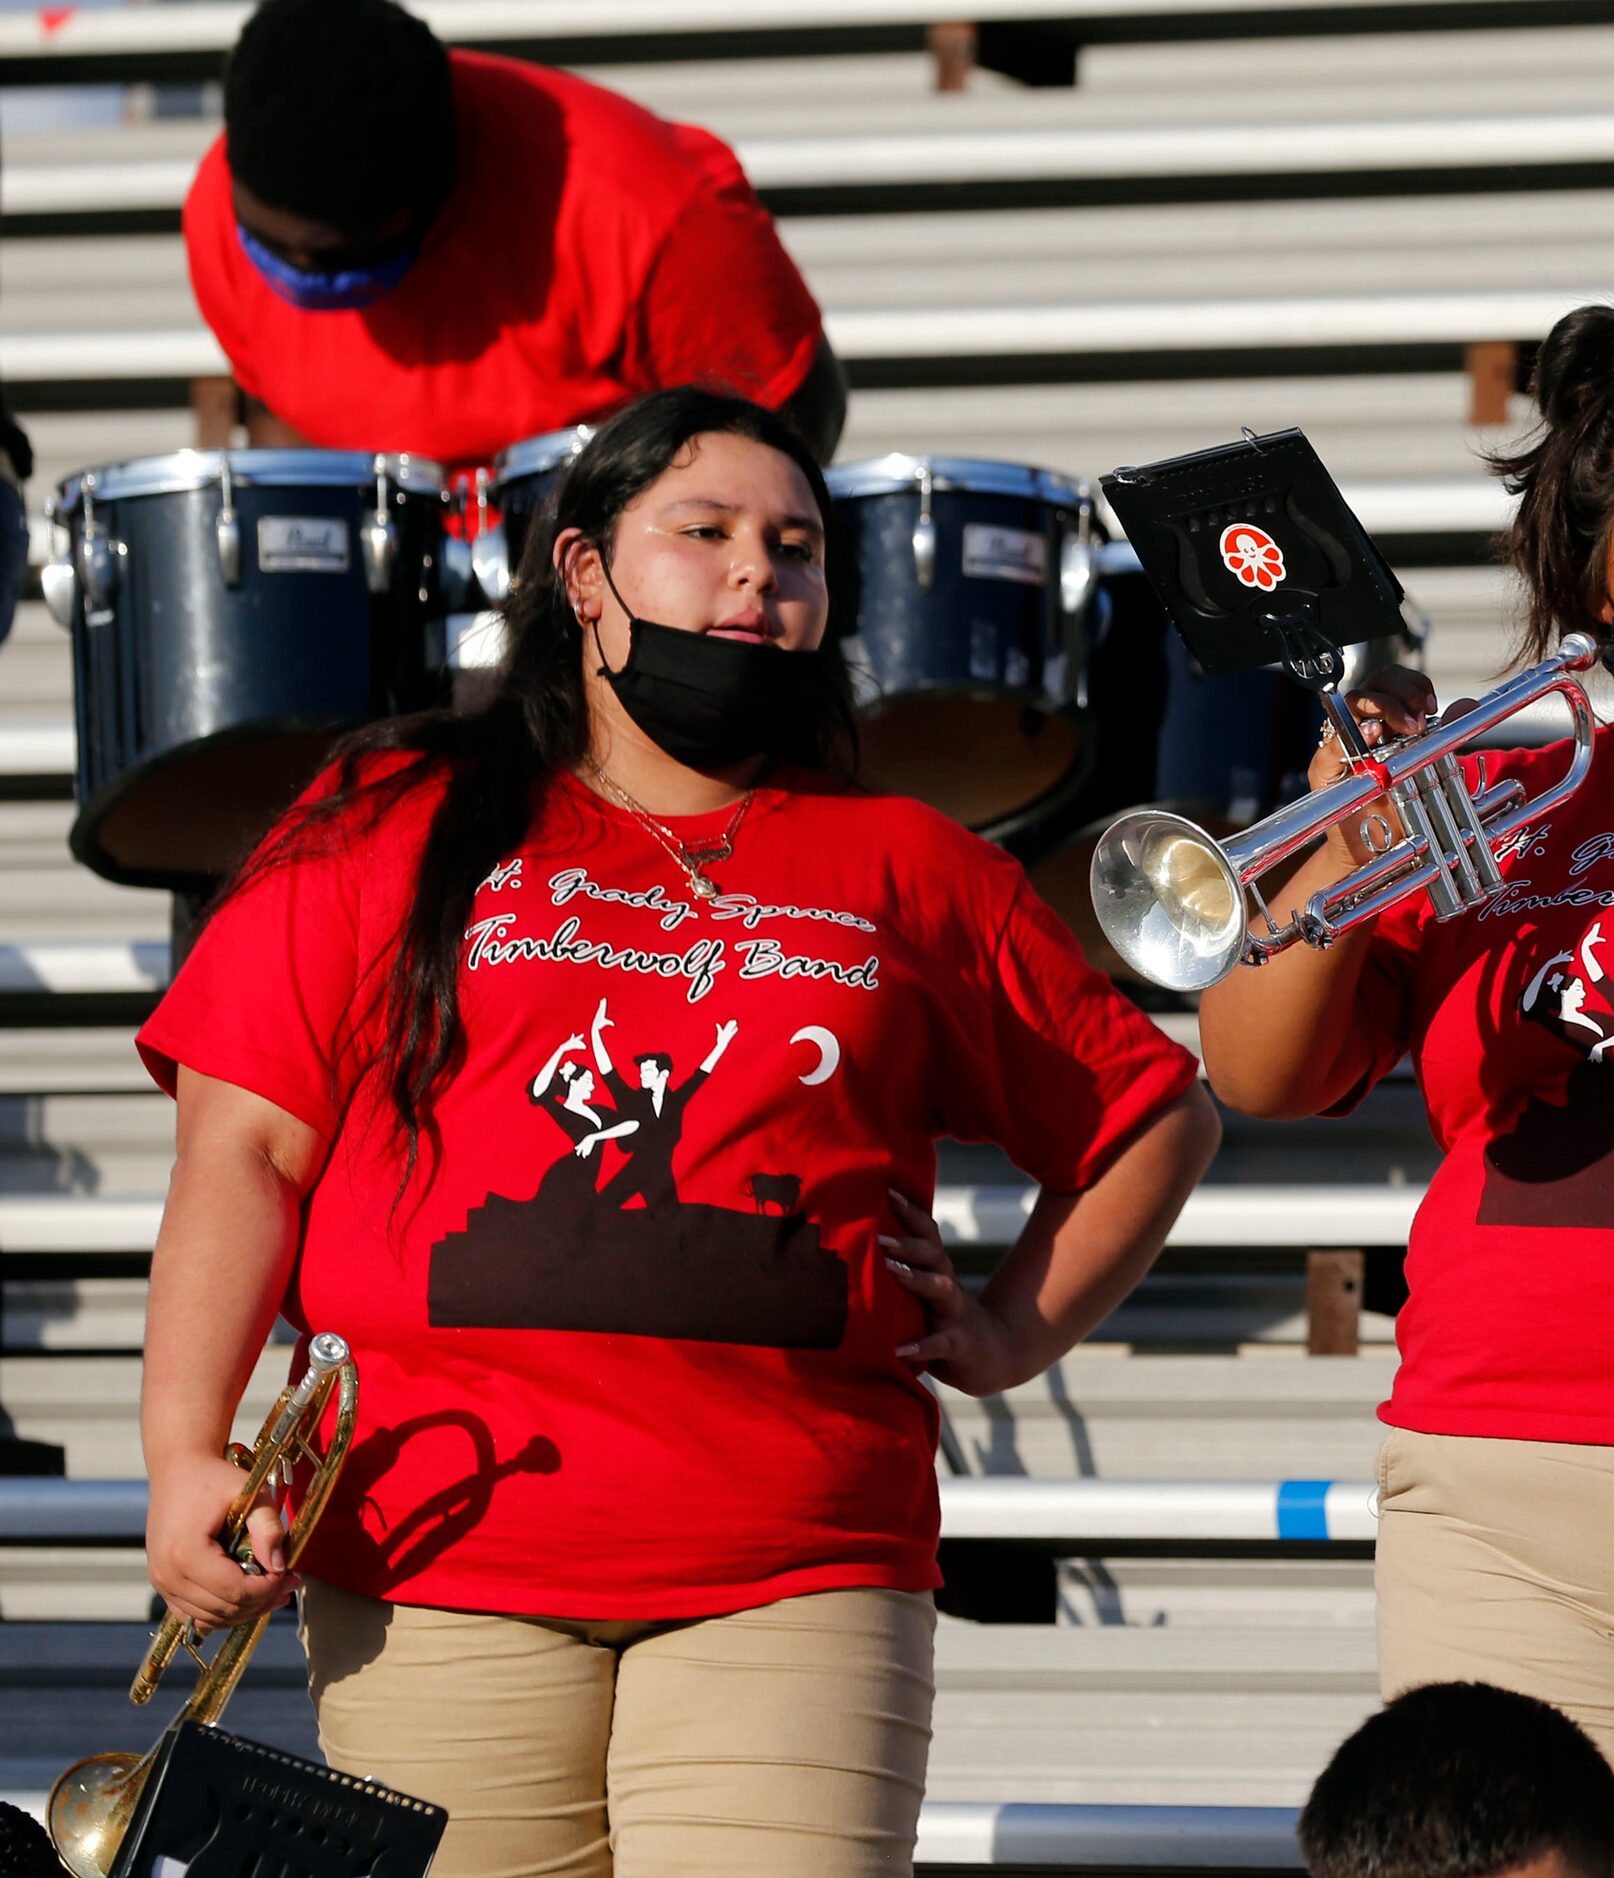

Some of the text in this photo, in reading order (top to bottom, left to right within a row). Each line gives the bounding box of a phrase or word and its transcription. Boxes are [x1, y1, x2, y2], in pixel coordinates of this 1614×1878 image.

[548, 867, 698, 930] Grady
[707, 893, 877, 933] Spruce
[464, 912, 880, 1004] Timberwolf Band
